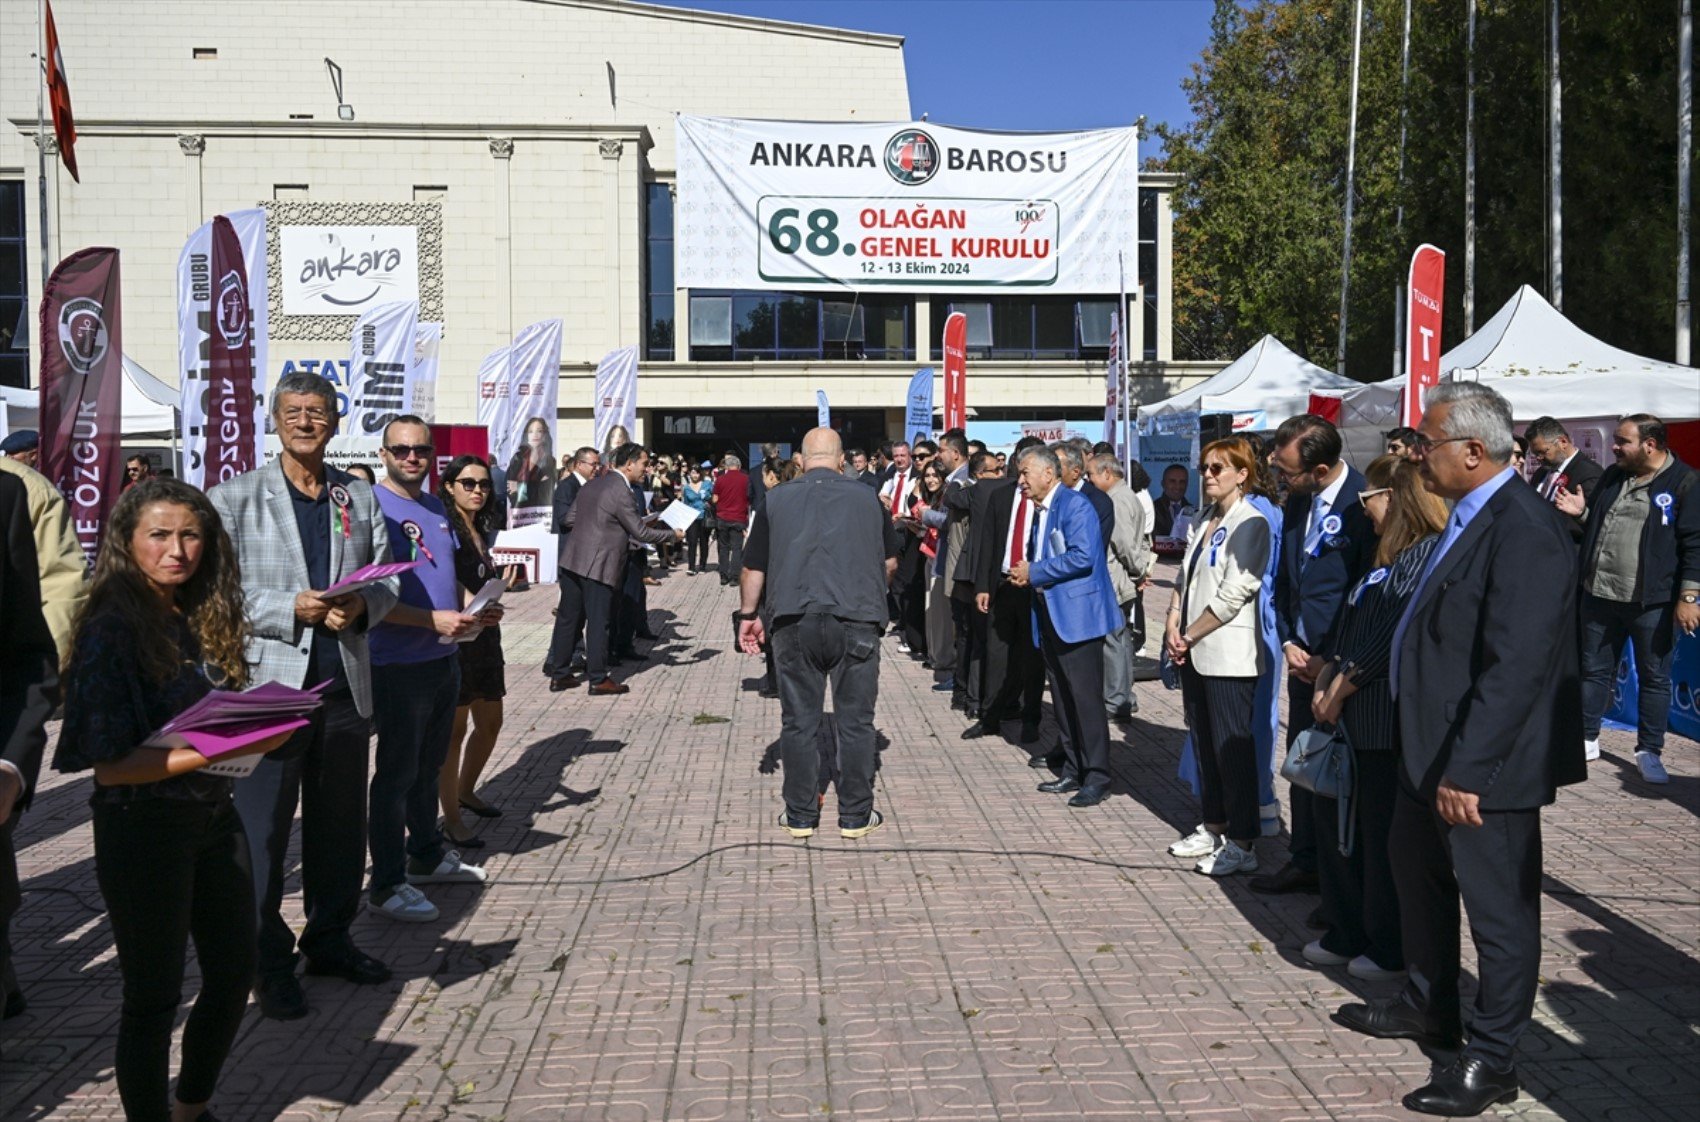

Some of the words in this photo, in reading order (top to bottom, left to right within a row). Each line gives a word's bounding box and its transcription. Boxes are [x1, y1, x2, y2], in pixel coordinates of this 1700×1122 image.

[750, 142, 876, 168] ANKARA
[947, 147, 1067, 172] BAROSU
[860, 203, 966, 230] OLAĞAN
[768, 208, 856, 257] 68.
[860, 237, 941, 258] GENEL
[952, 237, 1050, 259] KURULU
[191, 253, 208, 302] GRUBU
[861, 262, 875, 273] 12
[887, 262, 902, 273] 13
[906, 262, 936, 274] Ekim
[940, 262, 970, 274] 2024
[362, 323, 376, 356] GRUBU
